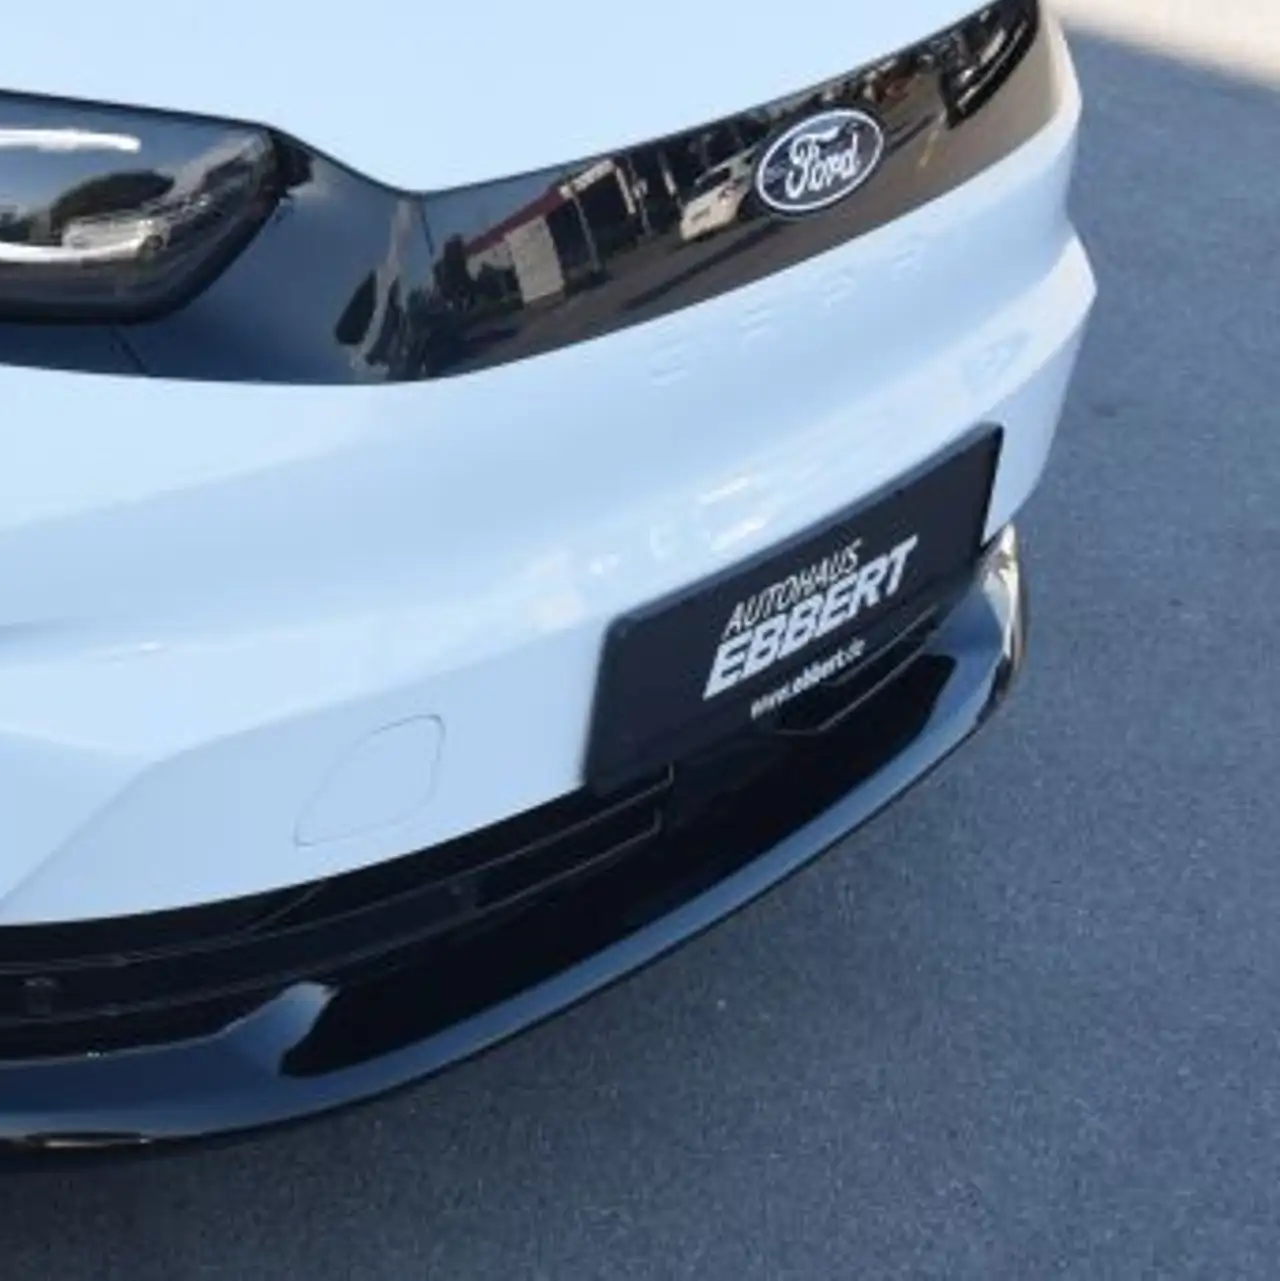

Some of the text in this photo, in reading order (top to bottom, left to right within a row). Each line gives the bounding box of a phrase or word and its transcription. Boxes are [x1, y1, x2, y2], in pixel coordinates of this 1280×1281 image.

[786, 125, 861, 199] Ford
[703, 534, 918, 701] EBBERT
[721, 538, 863, 641] AUTOHAUS
[751, 638, 866, 719] www.ebbert.de
